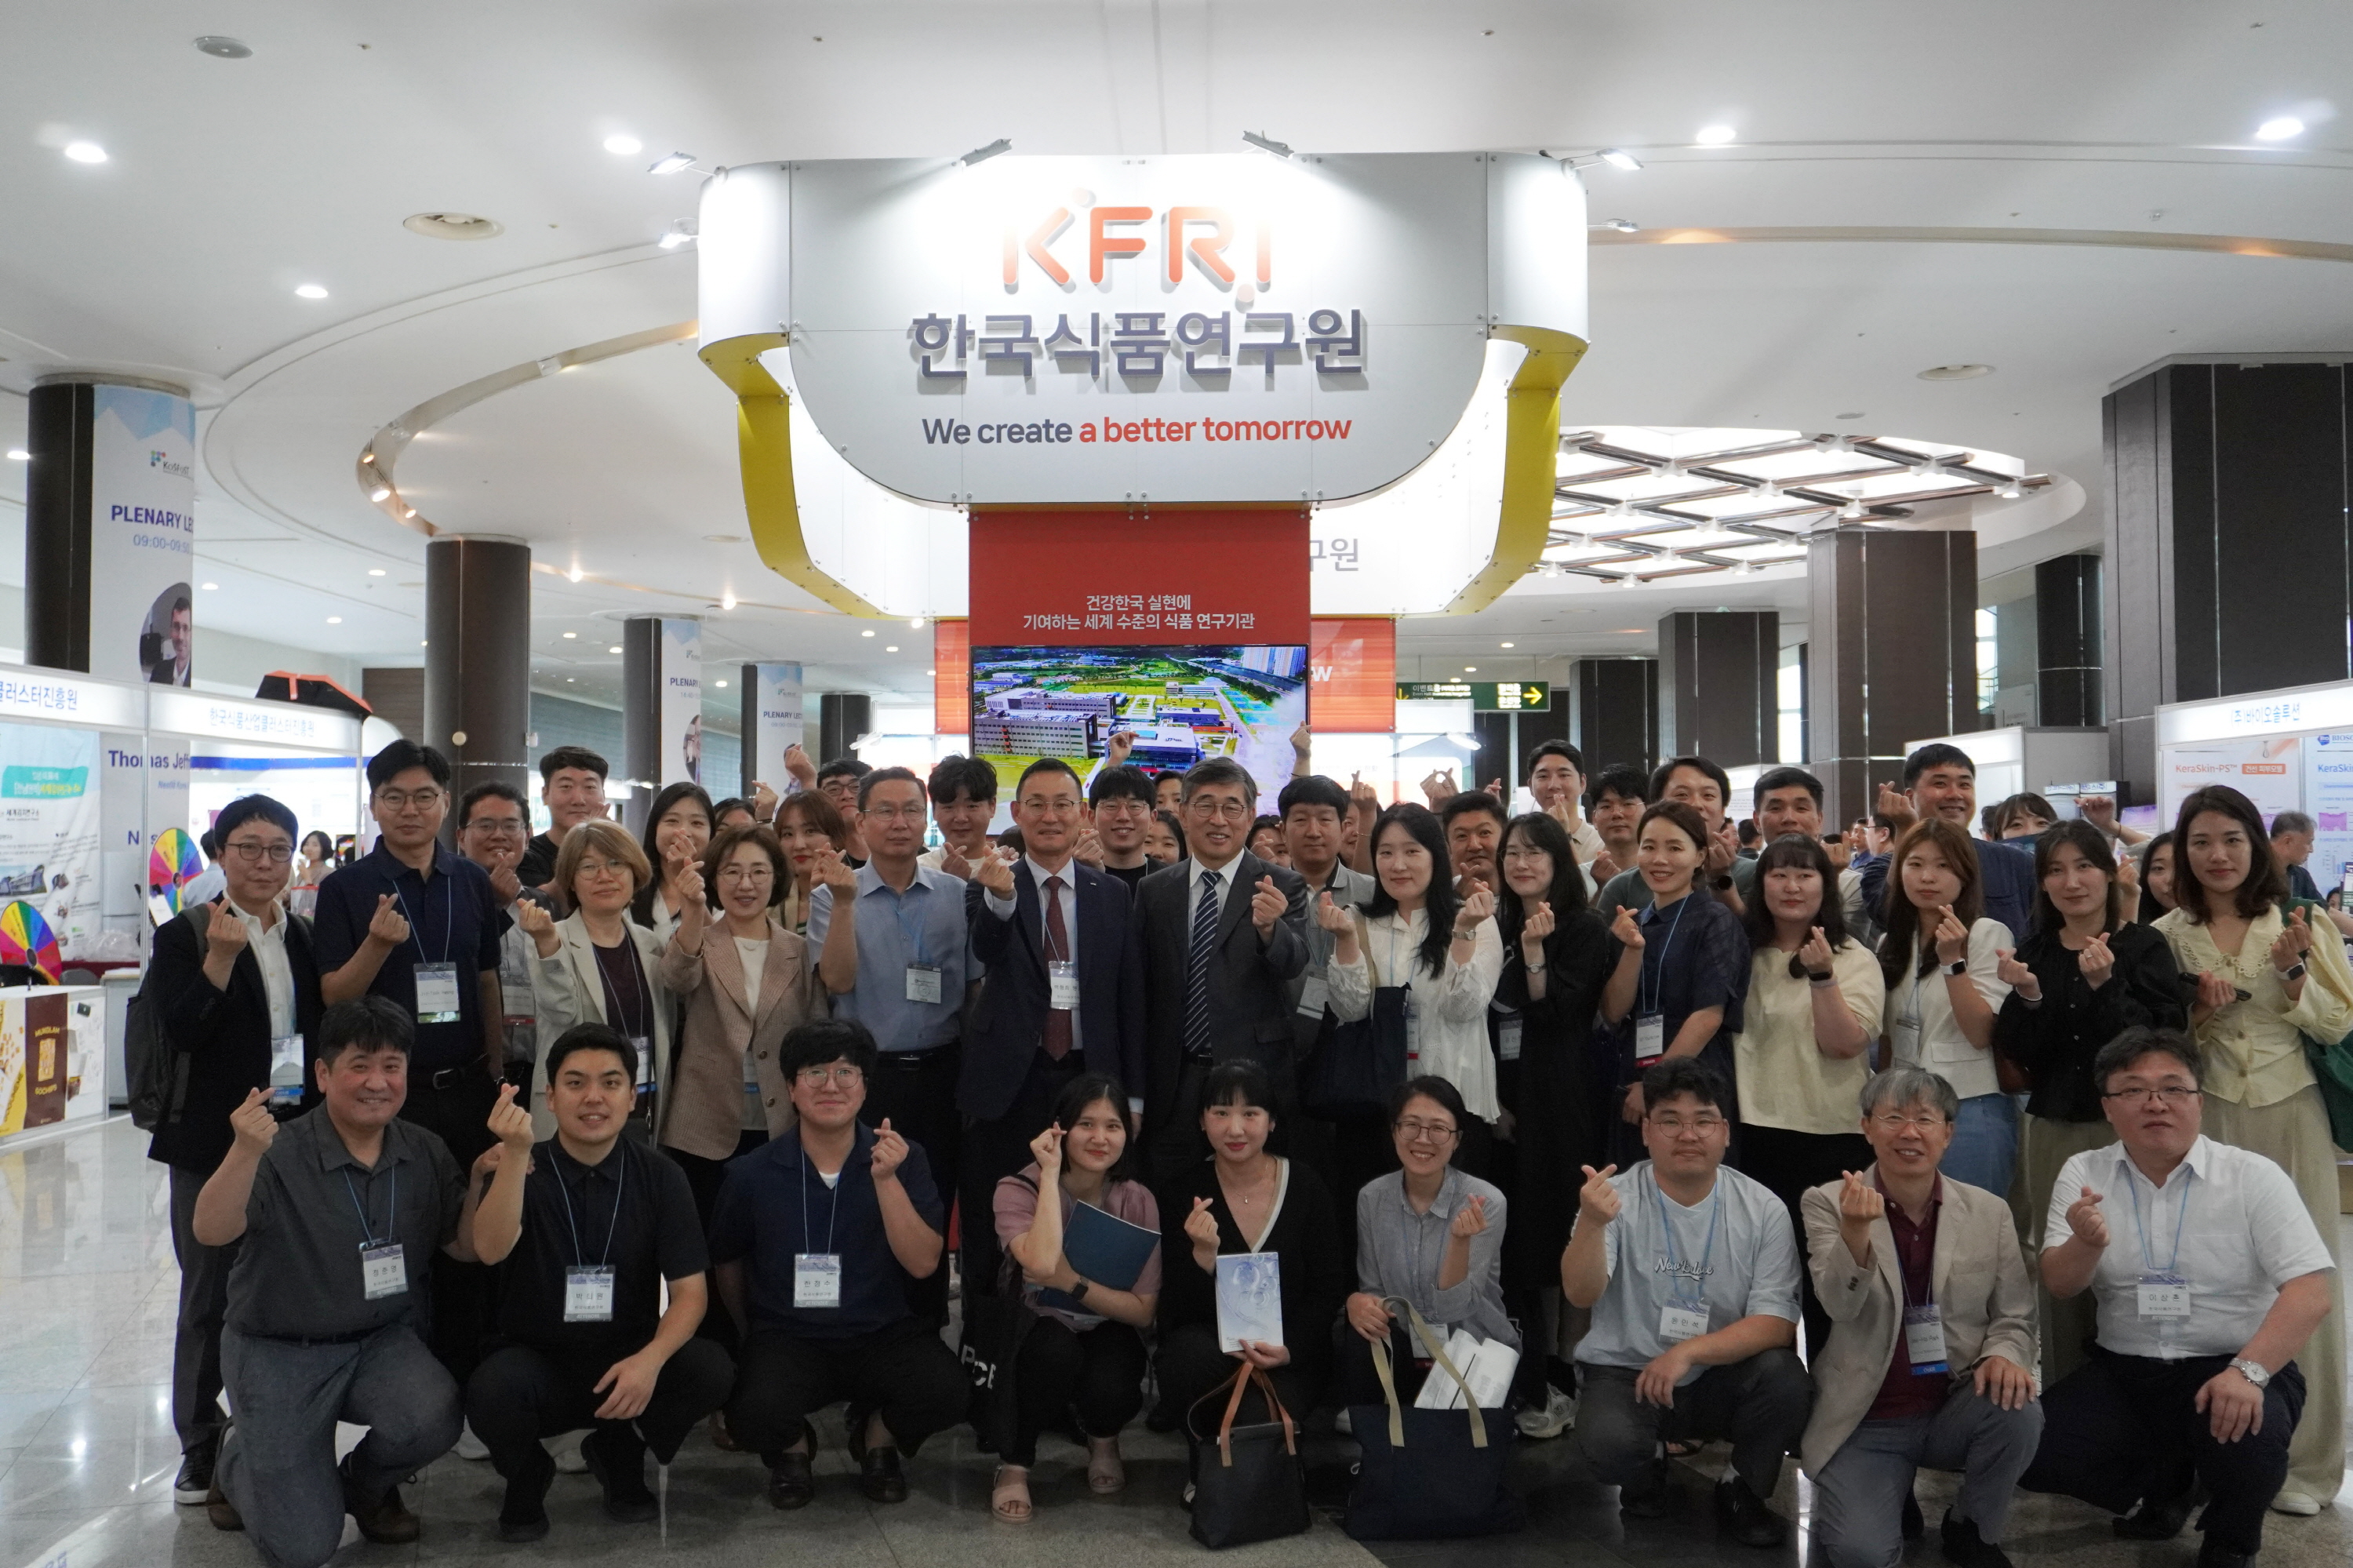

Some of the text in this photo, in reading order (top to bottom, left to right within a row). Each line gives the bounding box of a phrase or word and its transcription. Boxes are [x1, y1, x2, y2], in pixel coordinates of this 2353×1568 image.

[1002, 206, 1271, 286] KFRI
[911, 309, 1363, 377] 한국식품연구원
[922, 416, 1352, 444] We create a better tomorrow
[111, 504, 181, 529] PLENARY
[1086, 595, 1191, 611] 건강한국 실현에
[1023, 613, 1255, 630] 기여하는 세계 수준의 식품 연구기관
[670, 677, 698, 688] PLENARY
[210, 708, 315, 737] 한국식품산업클러스터진흥원
[2231, 703, 2300, 727] (주)바이오솔루션
